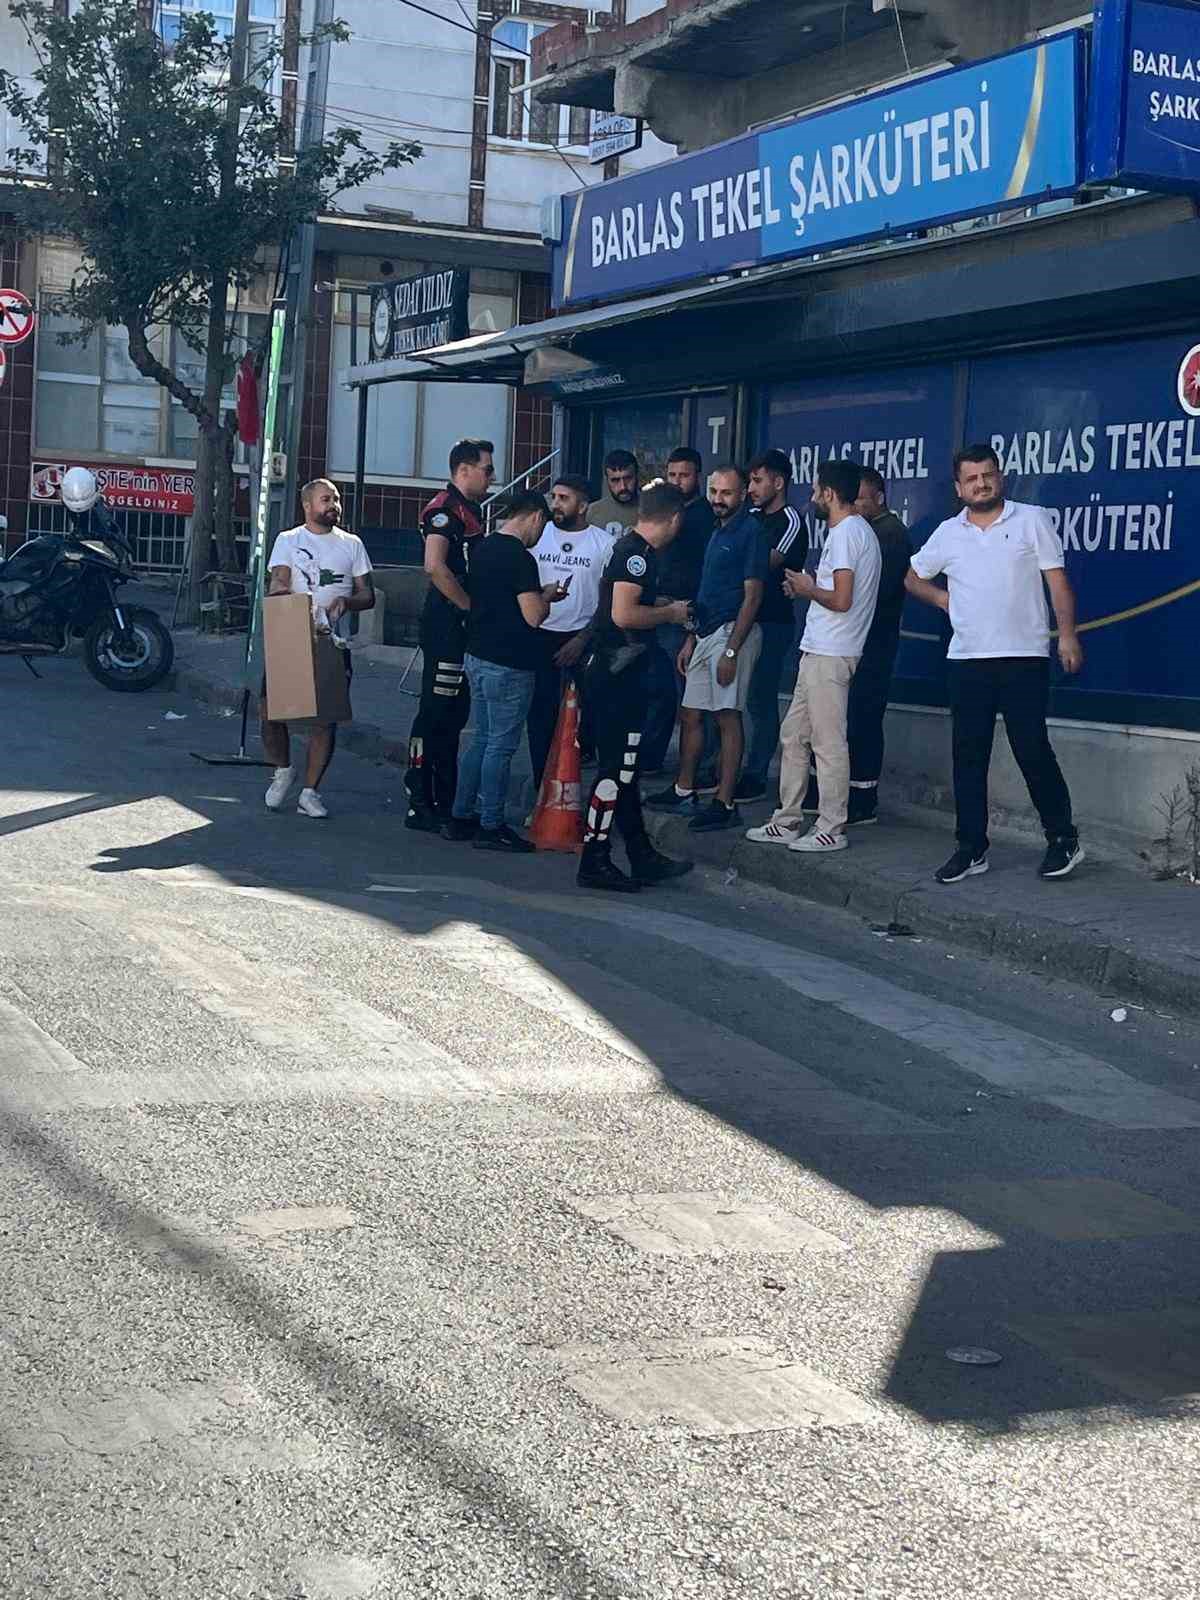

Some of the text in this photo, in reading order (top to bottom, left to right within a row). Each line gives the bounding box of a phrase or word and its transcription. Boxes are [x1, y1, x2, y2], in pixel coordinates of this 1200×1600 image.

[1150, 90, 1200, 121] ŞARK
[591, 80, 990, 267] BARLAS TEKEL ŞARKÜTERİ
[393, 270, 454, 320] SEDAT YILDIZ
[859, 437, 929, 480] TEKEL
[1105, 419, 1200, 471] TEKEL
[562, 555, 592, 569] JEANS
